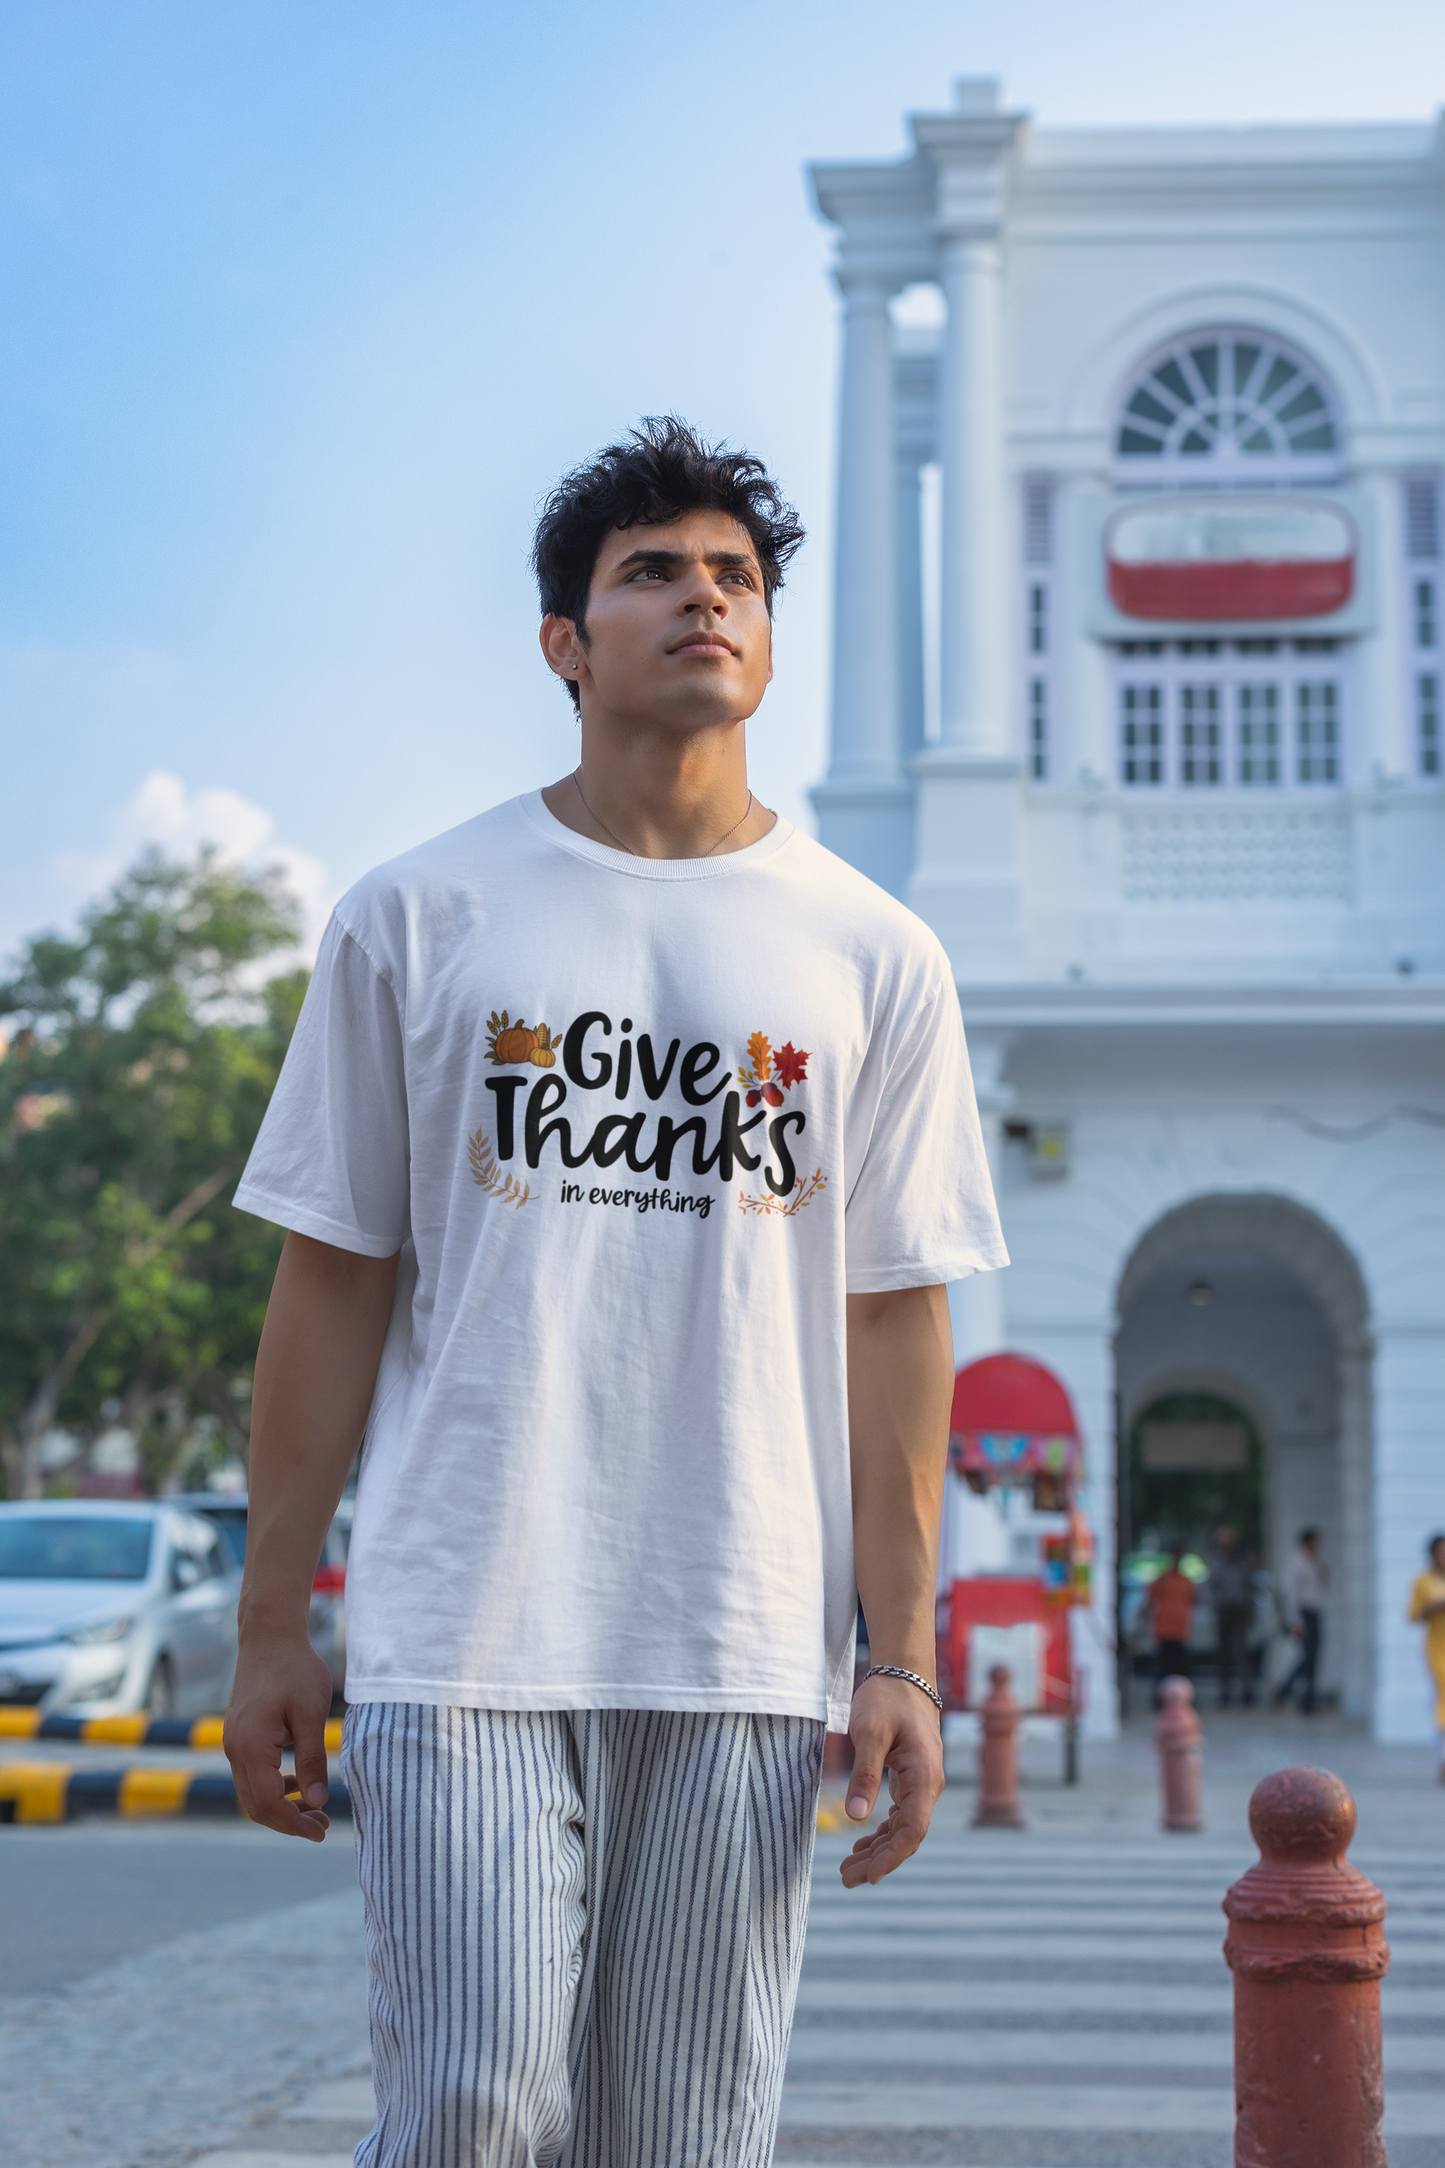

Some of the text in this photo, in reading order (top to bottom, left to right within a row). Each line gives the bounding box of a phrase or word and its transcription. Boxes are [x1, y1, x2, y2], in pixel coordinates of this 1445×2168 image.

[563, 1011, 732, 1106] Give
[485, 1073, 806, 1197] Thanks
[561, 1180, 715, 1219] in everything
